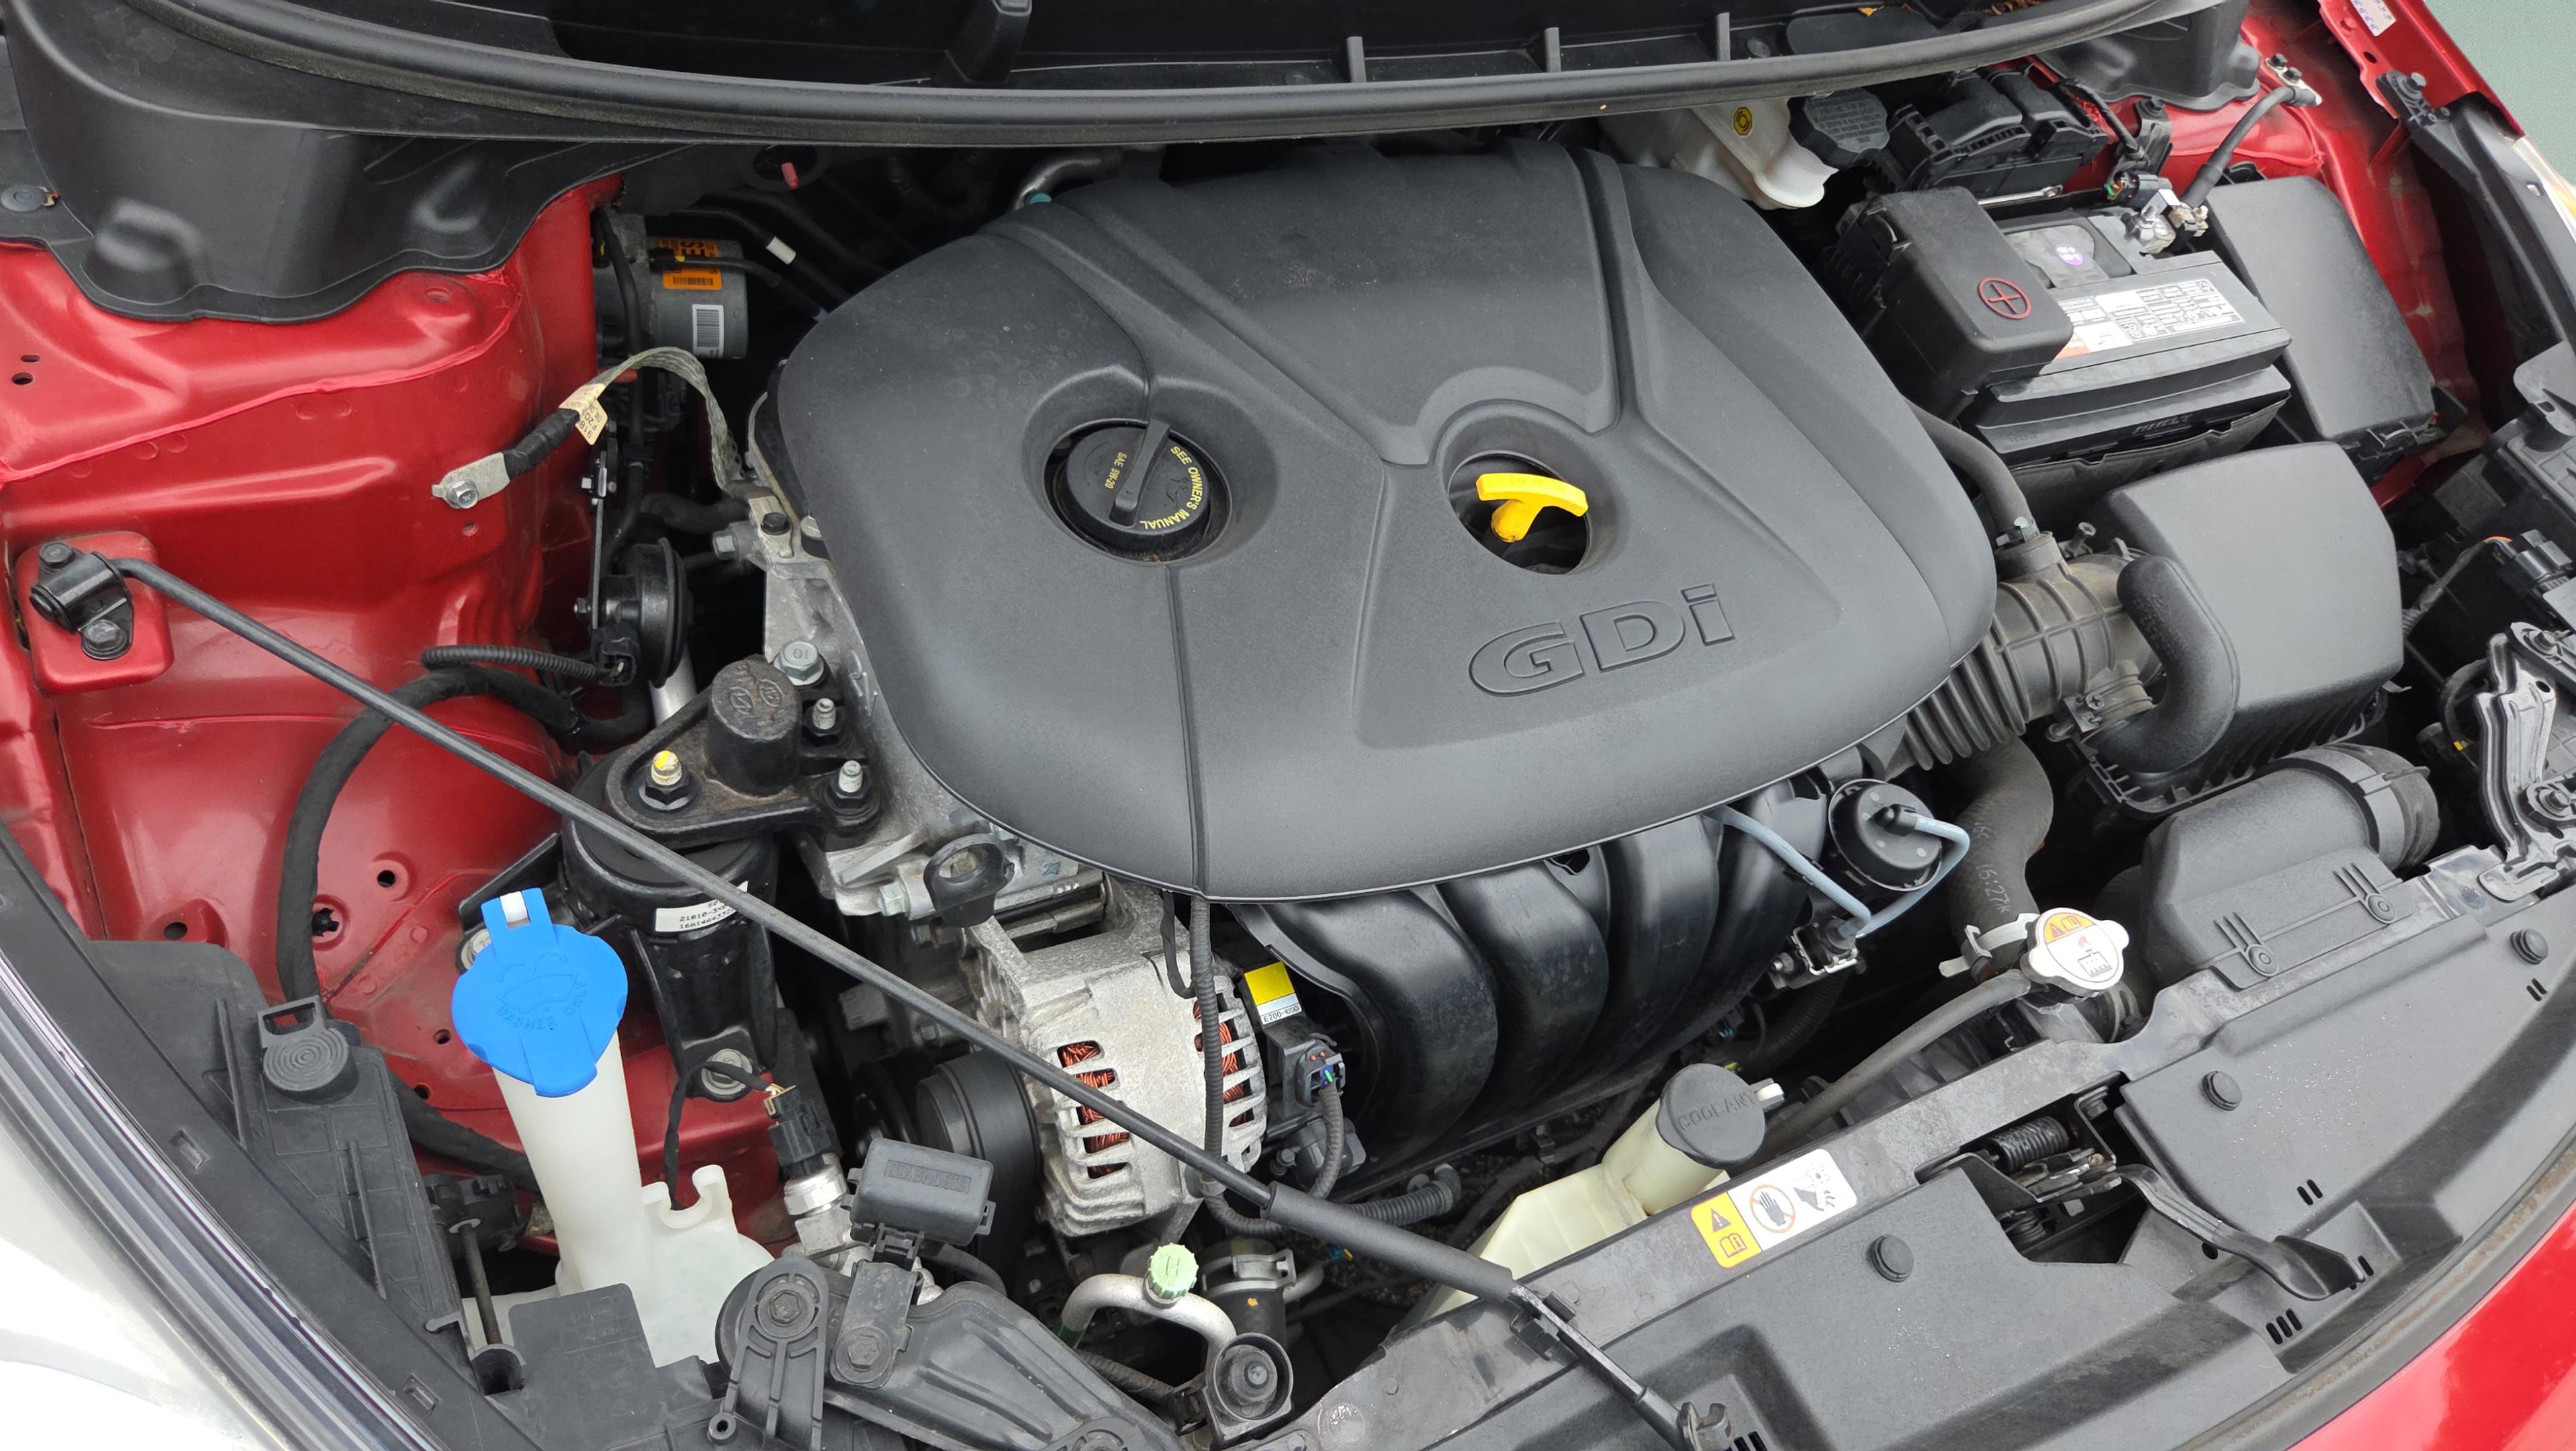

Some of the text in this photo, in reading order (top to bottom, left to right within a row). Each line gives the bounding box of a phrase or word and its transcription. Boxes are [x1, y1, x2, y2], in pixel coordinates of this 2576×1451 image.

[1114, 451, 1128, 468] SAE
[1140, 445, 1203, 531] SEE OWNER'S MANUAL
[1468, 582, 1736, 698] GDi
[496, 1006, 557, 1030] WASHER
[1677, 1090, 1754, 1131] COOLANT
[1165, 1255, 1181, 1277] H
